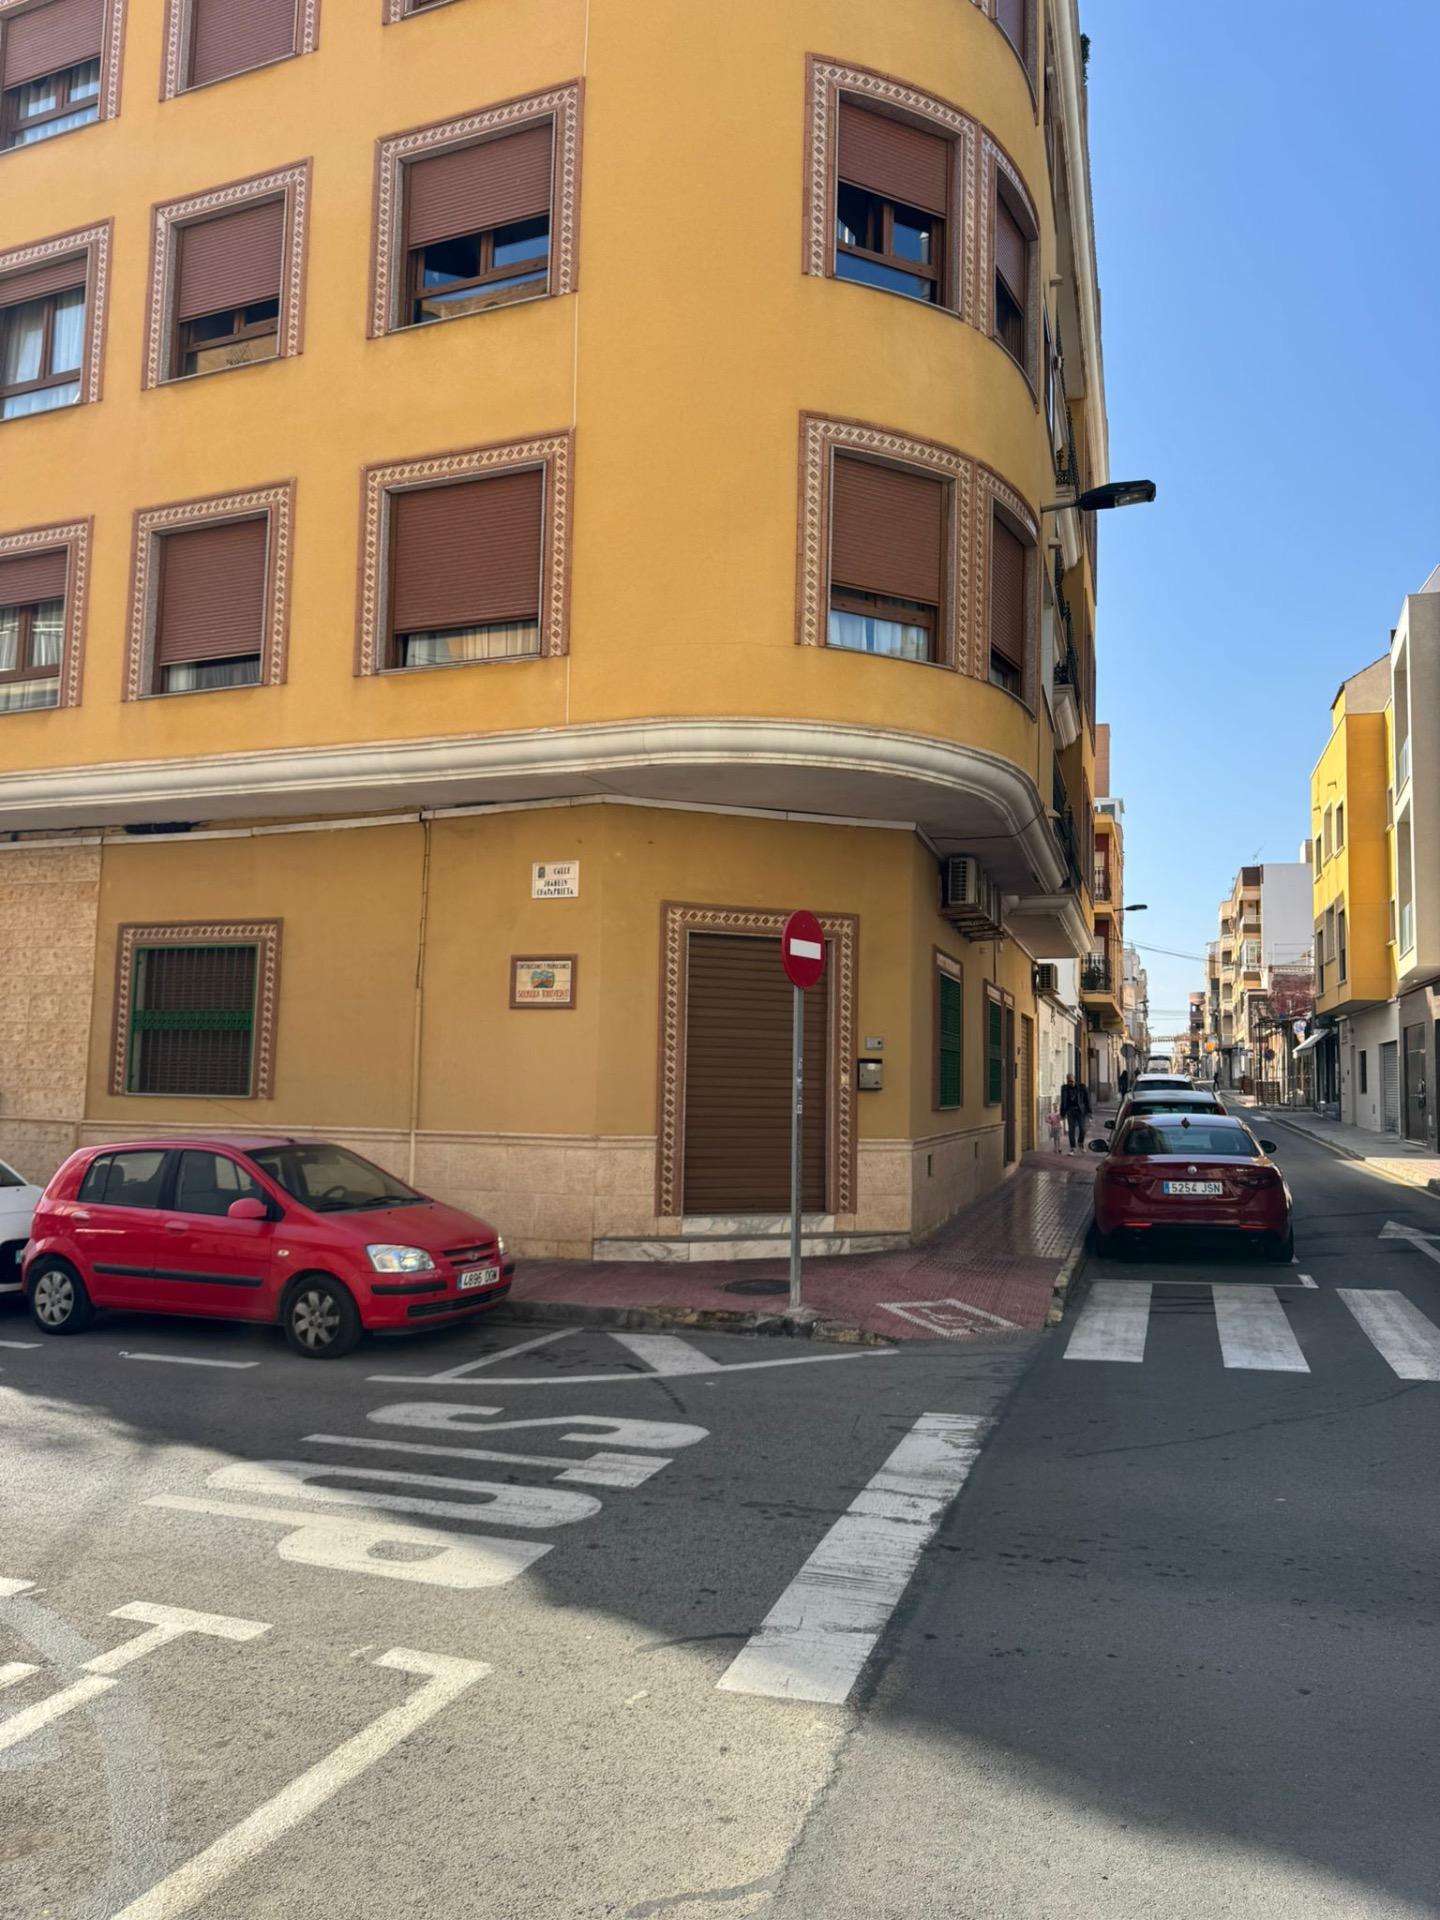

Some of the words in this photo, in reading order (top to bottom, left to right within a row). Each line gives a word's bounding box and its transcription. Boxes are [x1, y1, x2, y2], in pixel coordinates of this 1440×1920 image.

[553, 866, 571, 875] CALLE
[1171, 1183, 1197, 1192] 5254
[1201, 1183, 1221, 1193] JSN
[140, 1401, 711, 1589] STOP
